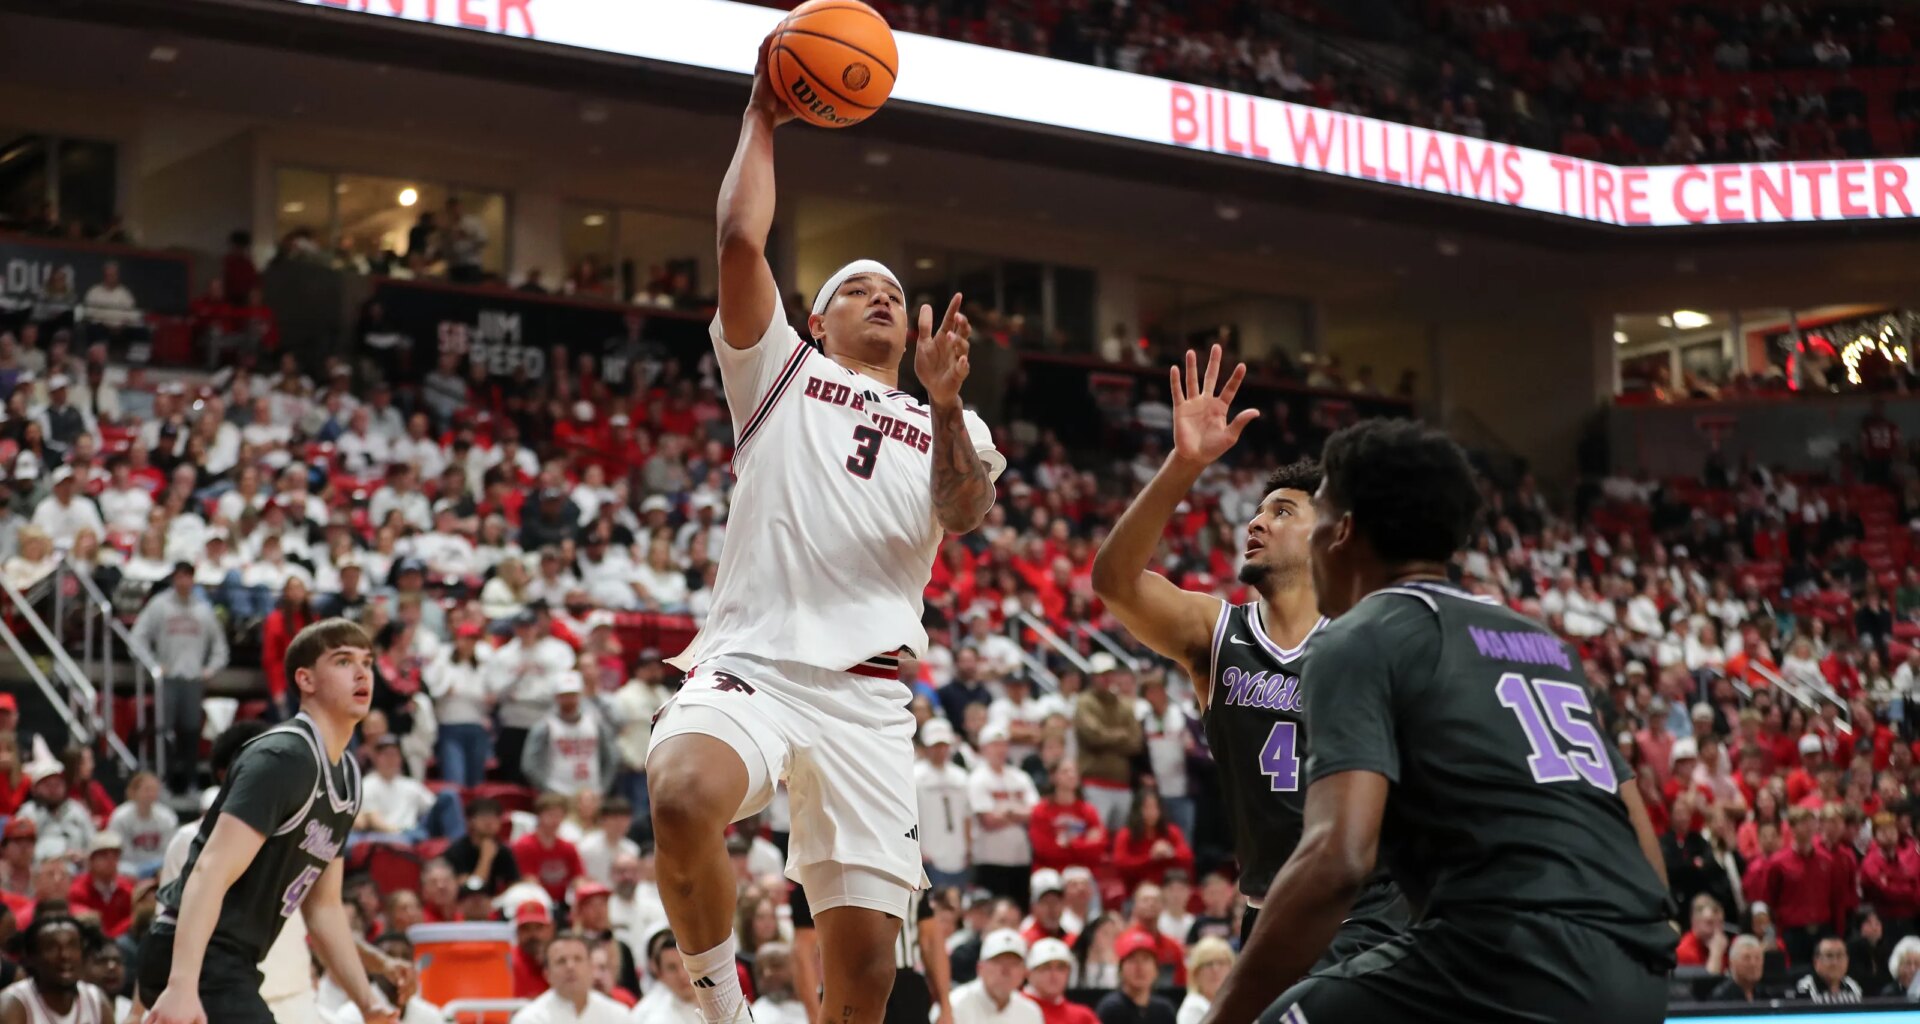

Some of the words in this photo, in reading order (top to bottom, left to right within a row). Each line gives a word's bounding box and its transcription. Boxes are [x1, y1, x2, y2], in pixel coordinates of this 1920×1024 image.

[1170, 83, 1269, 160] BILL
[1285, 104, 1524, 205] WILLIAMS
[1550, 156, 1651, 224] TIRE
[1672, 161, 1912, 223] CENTER
[804, 376, 851, 406] RED
[846, 424, 883, 480] 3
[1259, 721, 1300, 792] 4
[1495, 672, 1618, 794] 15
